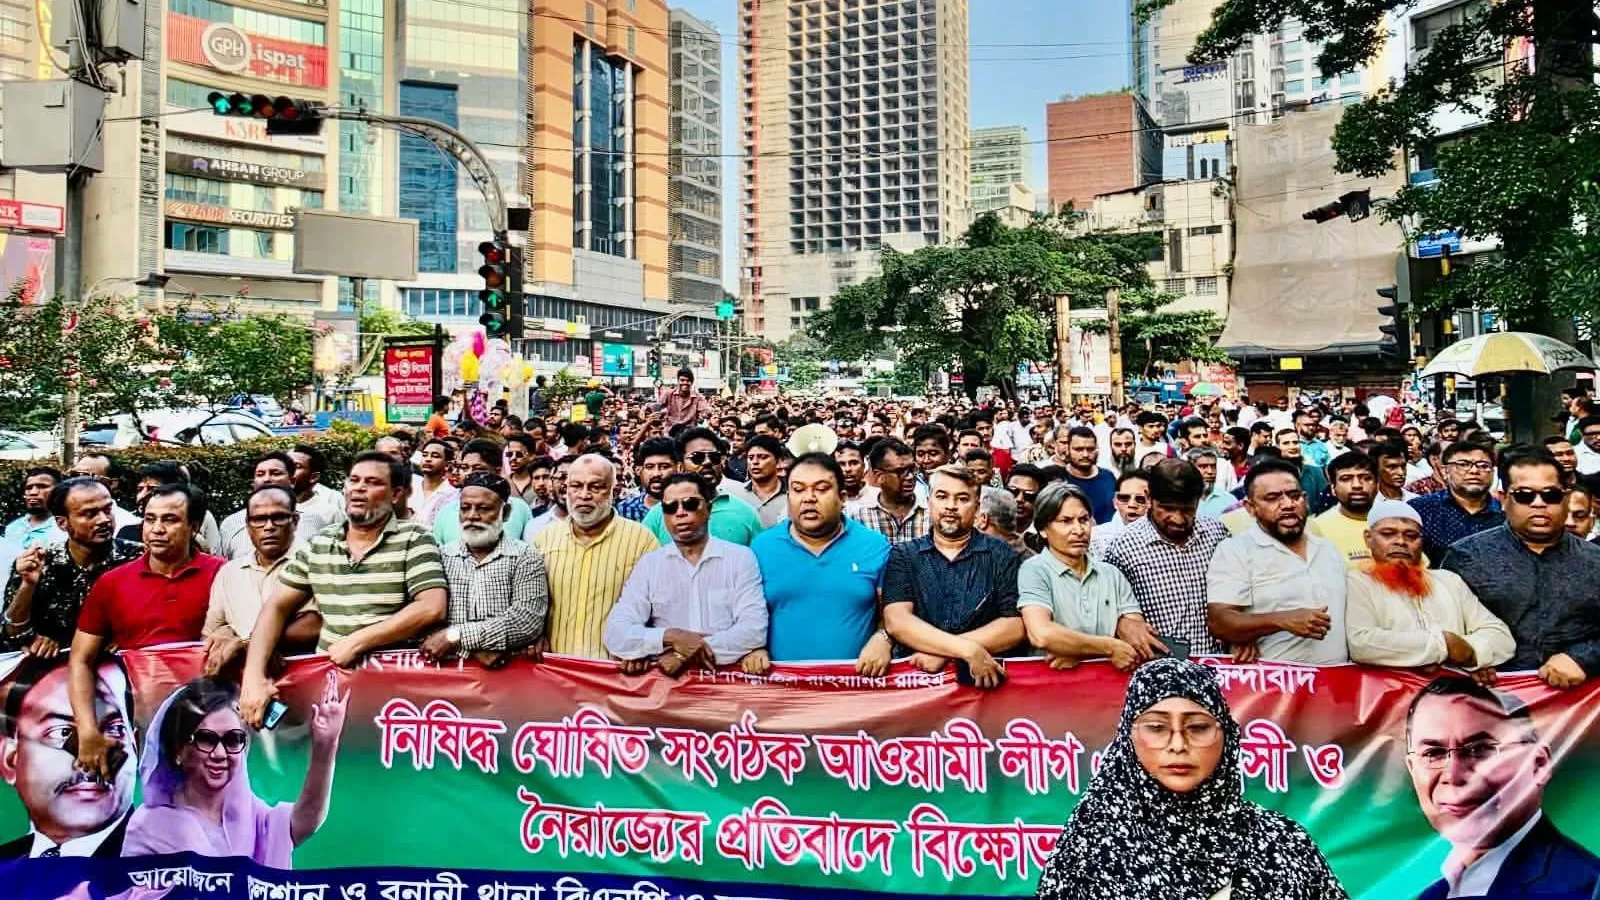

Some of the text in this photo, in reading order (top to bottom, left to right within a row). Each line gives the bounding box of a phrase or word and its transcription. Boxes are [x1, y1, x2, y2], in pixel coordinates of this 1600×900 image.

[211, 36, 305, 69] GPH ispat
[210, 159, 305, 180] AHSAN GROUP
[229, 211, 294, 228] SECURITIES
[374, 697, 506, 774] নিষিদ্ধ
[512, 701, 655, 778] ঘোষিত
[657, 711, 811, 788] সংগঠক
[814, 717, 994, 793] আওয়ামী
[997, 718, 1084, 796] লীগ
[1303, 743, 1345, 790] ও
[518, 786, 709, 866] নৈরাজ্যের
[716, 796, 902, 875] প্রতিবাদে
